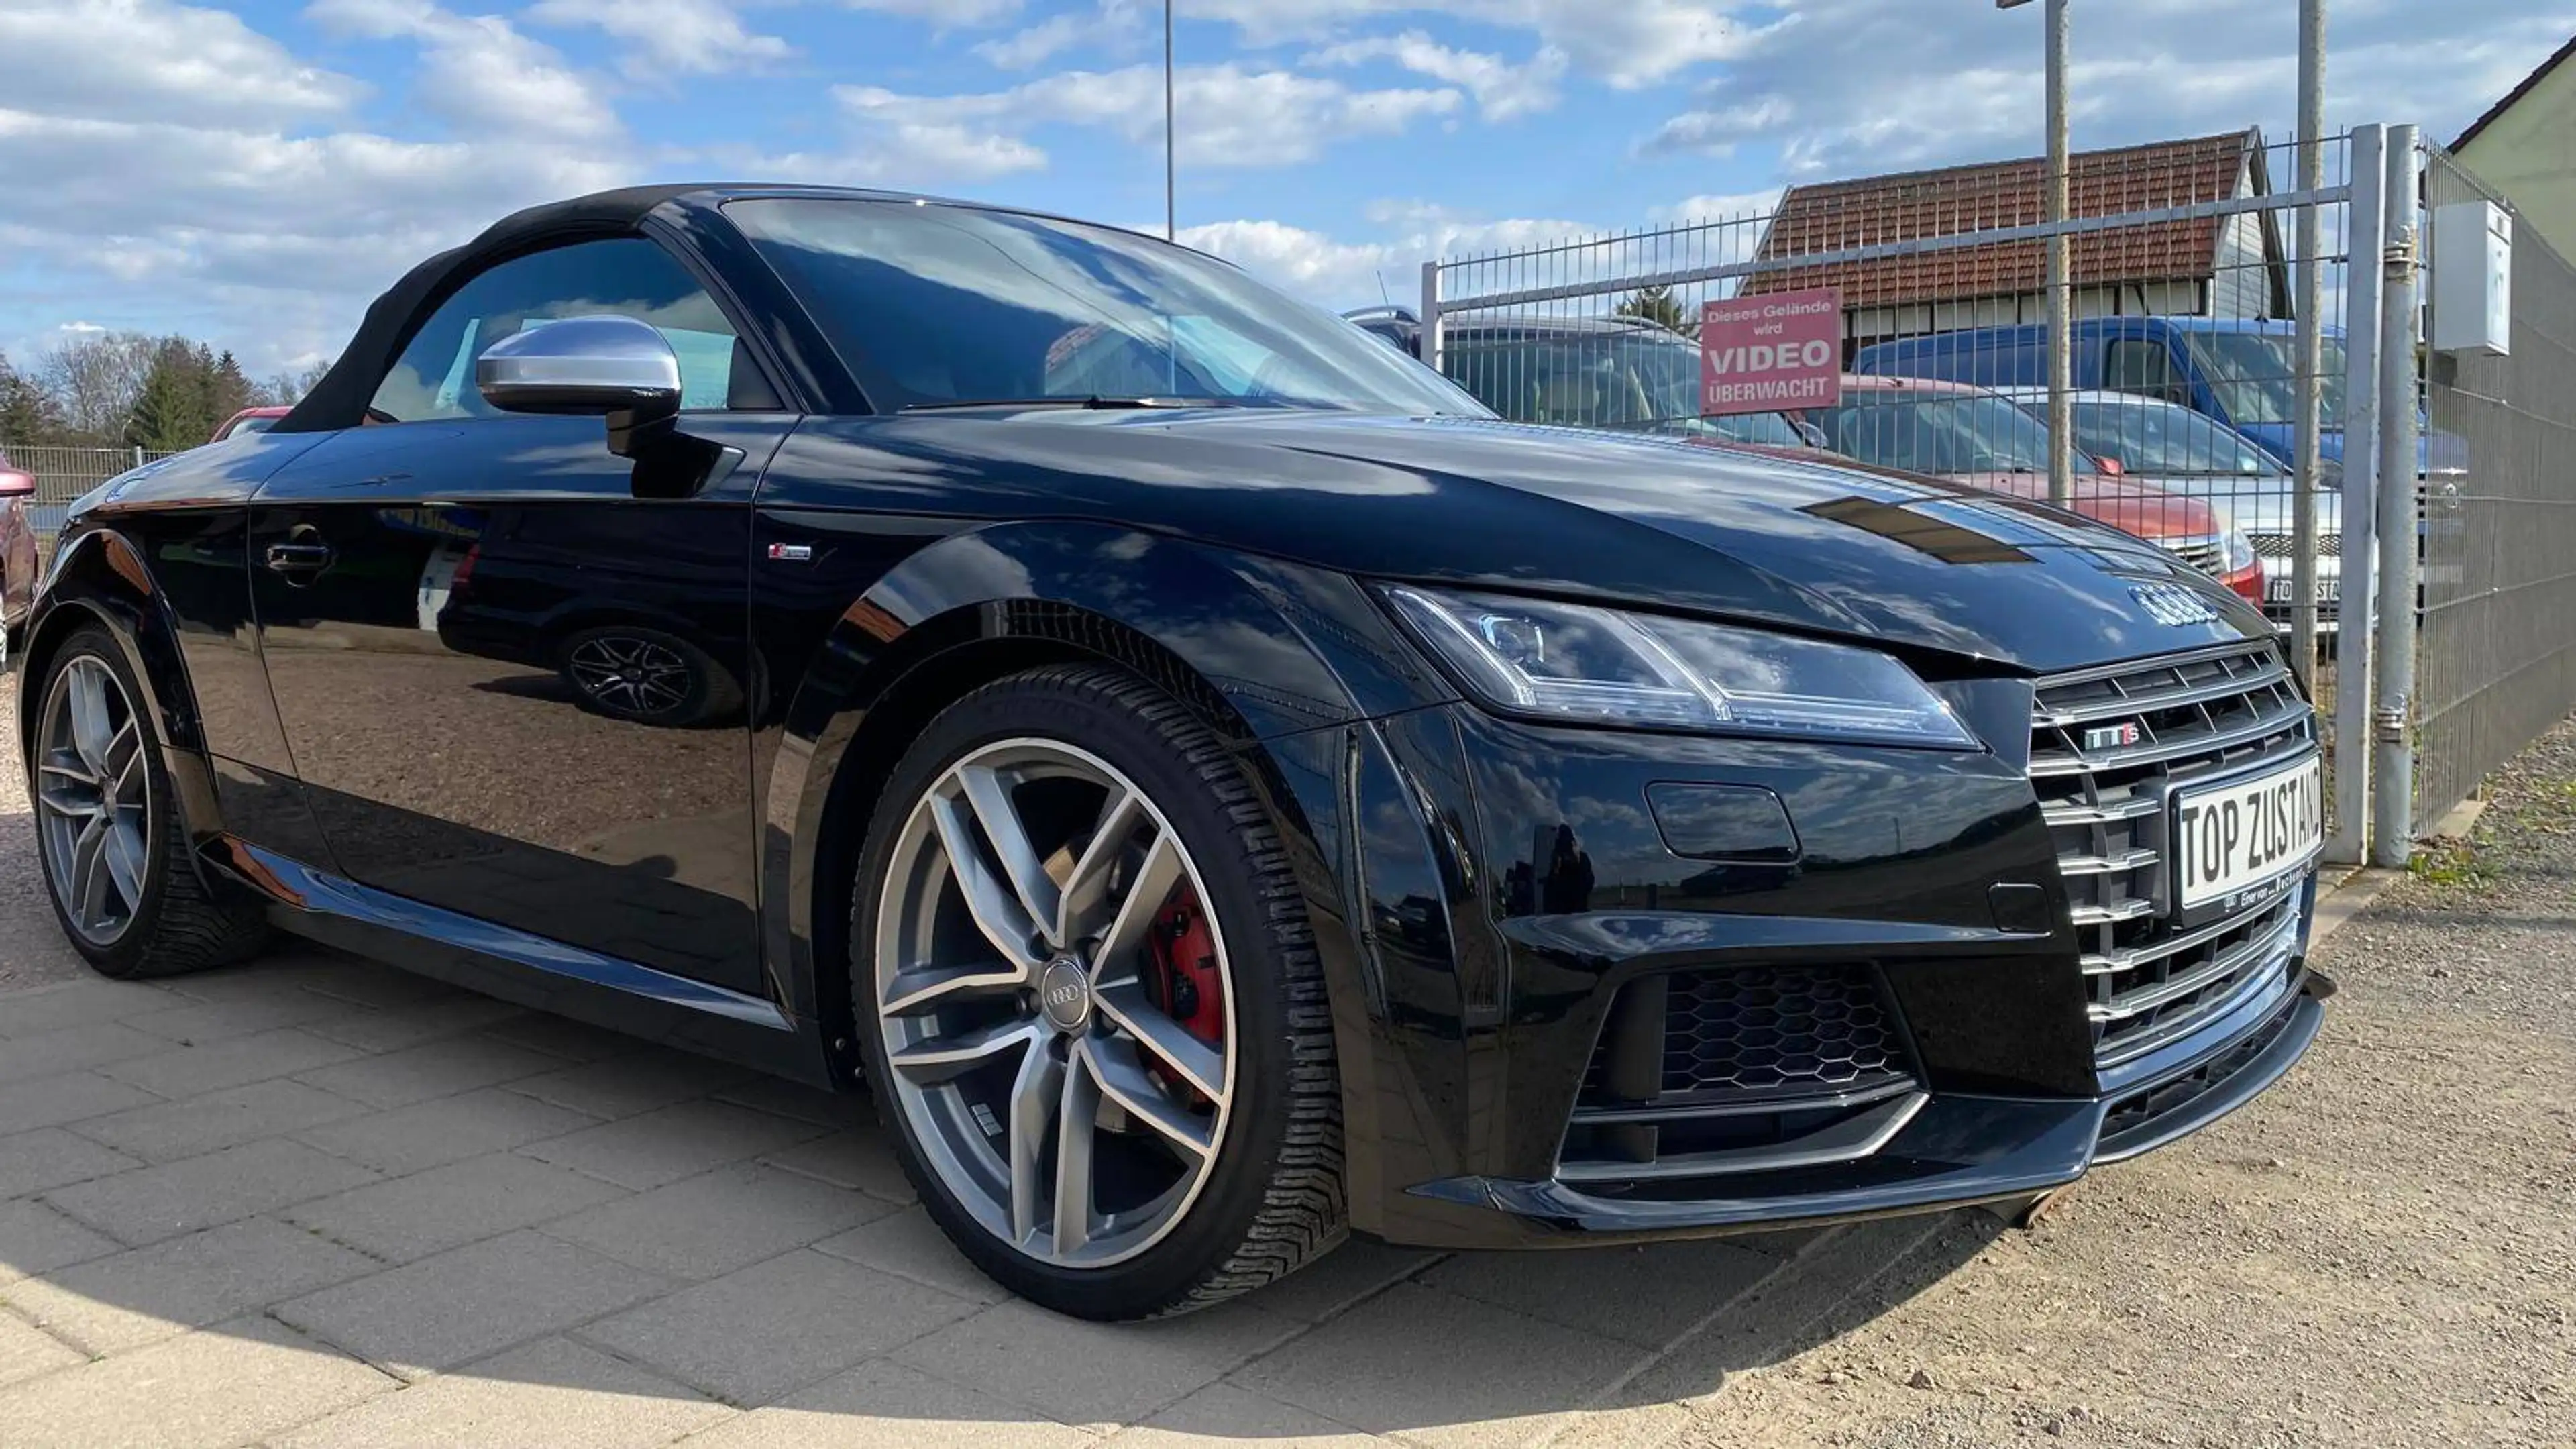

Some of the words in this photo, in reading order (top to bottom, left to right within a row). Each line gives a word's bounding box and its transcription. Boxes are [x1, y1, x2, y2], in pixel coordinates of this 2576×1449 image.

[1708, 308, 1759, 323] Dieses
[1763, 301, 1831, 317] Gelände
[1753, 322, 1783, 336] wird
[1708, 339, 1831, 374] VIDEO
[1709, 377, 1829, 404] ÜBERWACHT
[2182, 800, 2239, 888] TOP
[2247, 767, 2320, 869] ZUSTAND
